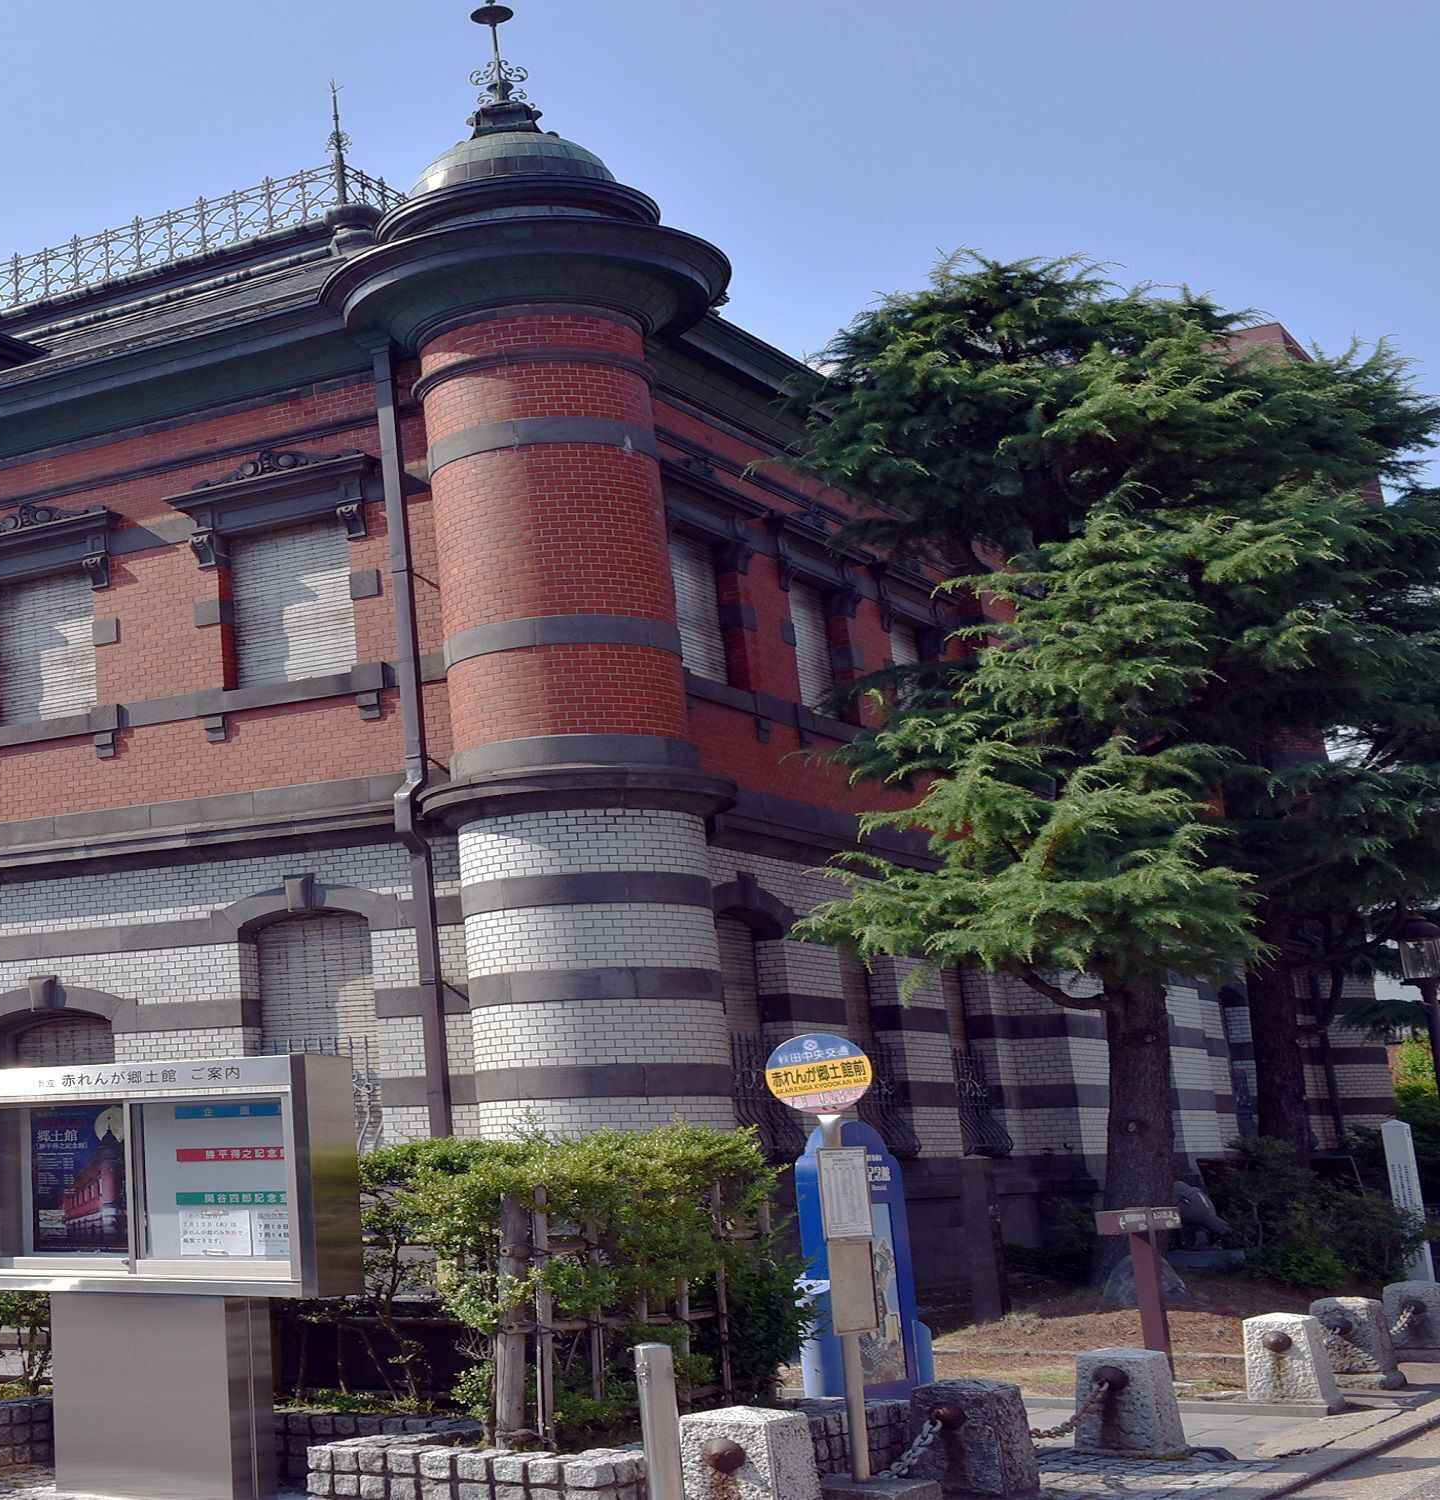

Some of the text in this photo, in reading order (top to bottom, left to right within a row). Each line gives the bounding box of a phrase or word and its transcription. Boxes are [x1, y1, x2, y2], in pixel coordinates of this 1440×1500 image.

[778, 1045, 850, 1064] 秋田中央交通
[61, 1069, 177, 1088] 赤れんが郷土館
[191, 1066, 241, 1081] ご案内
[771, 1060, 867, 1087] 赤れんが郷土館前
[775, 1083, 814, 1095] AKARENGA
[853, 1076, 868, 1084] MAE
[36, 1129, 78, 1142] 郷土館
